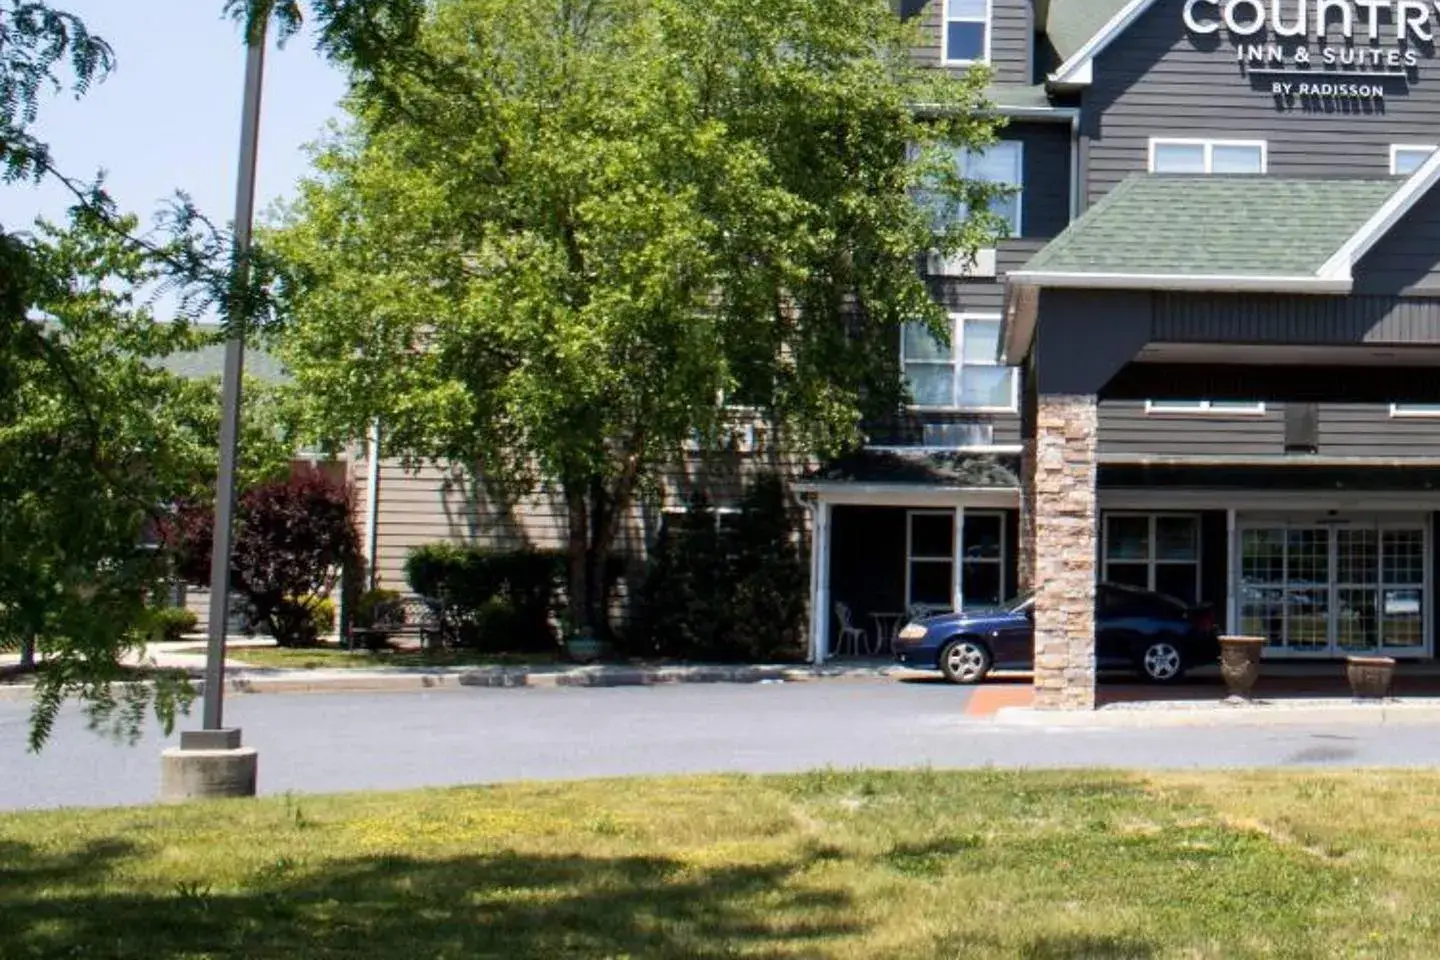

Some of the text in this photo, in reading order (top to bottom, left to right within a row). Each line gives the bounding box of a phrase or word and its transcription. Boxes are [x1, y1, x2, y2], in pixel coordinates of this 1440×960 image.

[1236, 44, 1417, 66] INN & SUITES
[1272, 82, 1384, 97] BY RADISSON
